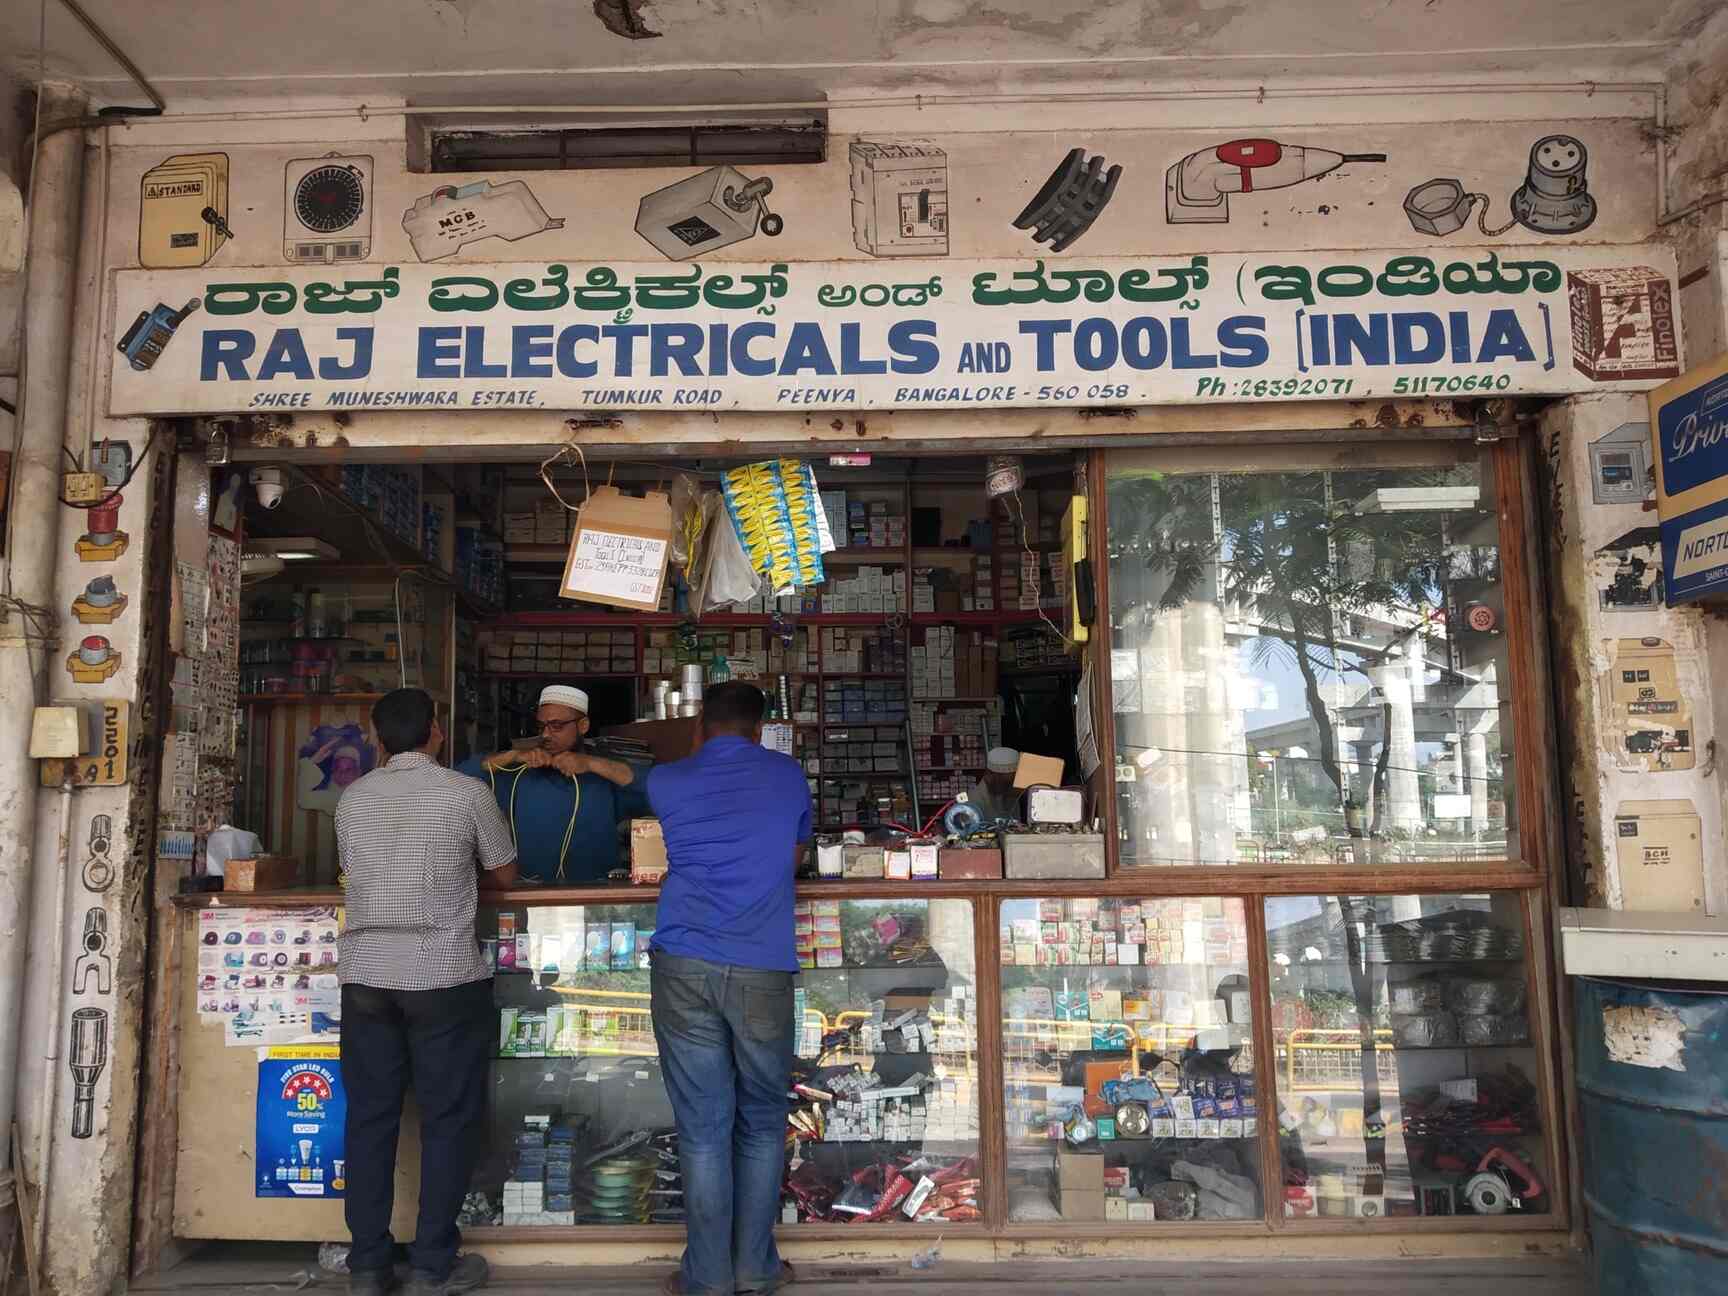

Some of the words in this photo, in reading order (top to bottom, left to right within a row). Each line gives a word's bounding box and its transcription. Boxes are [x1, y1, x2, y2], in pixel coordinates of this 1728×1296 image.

[438, 211, 476, 228] MCB
[204, 266, 400, 315] ರಾಜ್
[1651, 284, 1676, 361] Finolex
[200, 327, 375, 381] RAJ
[416, 319, 940, 379] ELECTRICALS
[957, 342, 1012, 374] AND
[1018, 315, 1270, 372] TOOLS
[249, 392, 312, 408] SHREE
[326, 391, 458, 406] MUNESHWARA
[581, 389, 663, 404] TUMKUR
[673, 389, 723, 404] ROAD
[776, 388, 856, 403] PEENYA
[894, 386, 1016, 402] BANGALORE
[1036, 386, 1080, 400] 560
[1086, 384, 1130, 399] 058
[1393, 374, 1512, 394] 51170640
